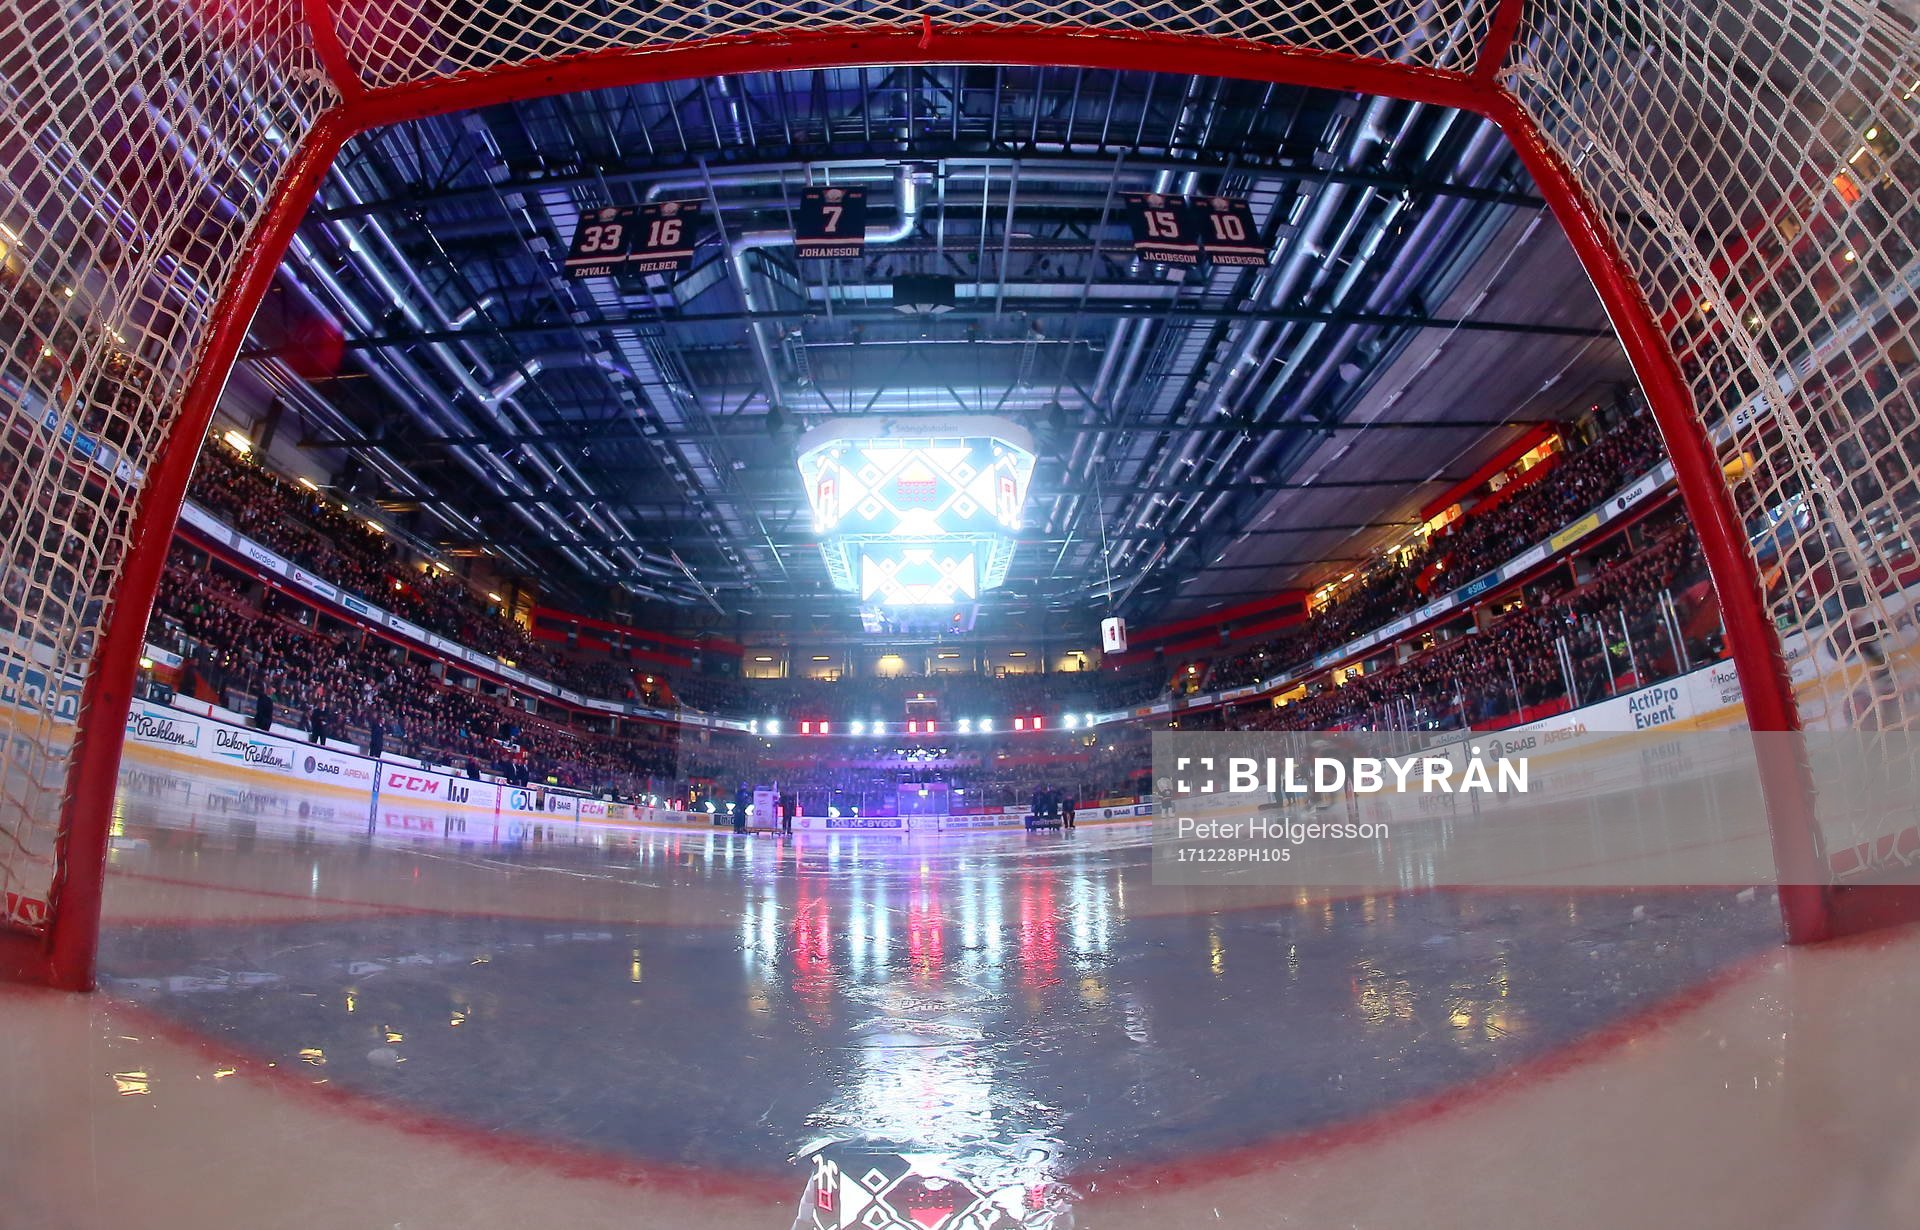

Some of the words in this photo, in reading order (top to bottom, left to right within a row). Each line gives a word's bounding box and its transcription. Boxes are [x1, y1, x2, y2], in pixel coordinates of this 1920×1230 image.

[822, 206, 843, 233] 7
[1144, 211, 1179, 238] 15
[1211, 214, 1246, 241] 10
[580, 224, 623, 252] 33
[647, 219, 682, 247] 16
[799, 248, 860, 257] JOHANSSON
[1143, 251, 1197, 264] JACOBSSON
[1212, 255, 1266, 265] ANDERSSON
[575, 266, 611, 277] EMVALL
[640, 261, 678, 272] HELBER
[249, 547, 276, 568] Nordea
[1628, 687, 1679, 714] ActiPro
[1635, 705, 1677, 729] Event
[1505, 737, 1537, 754] SAAB
[1543, 723, 1587, 746] ARENA
[317, 761, 340, 775] SAAB
[342, 767, 370, 780] ARENA
[387, 773, 440, 794] CCM
[557, 801, 571, 810] SAAB
[581, 804, 604, 815] CCM
